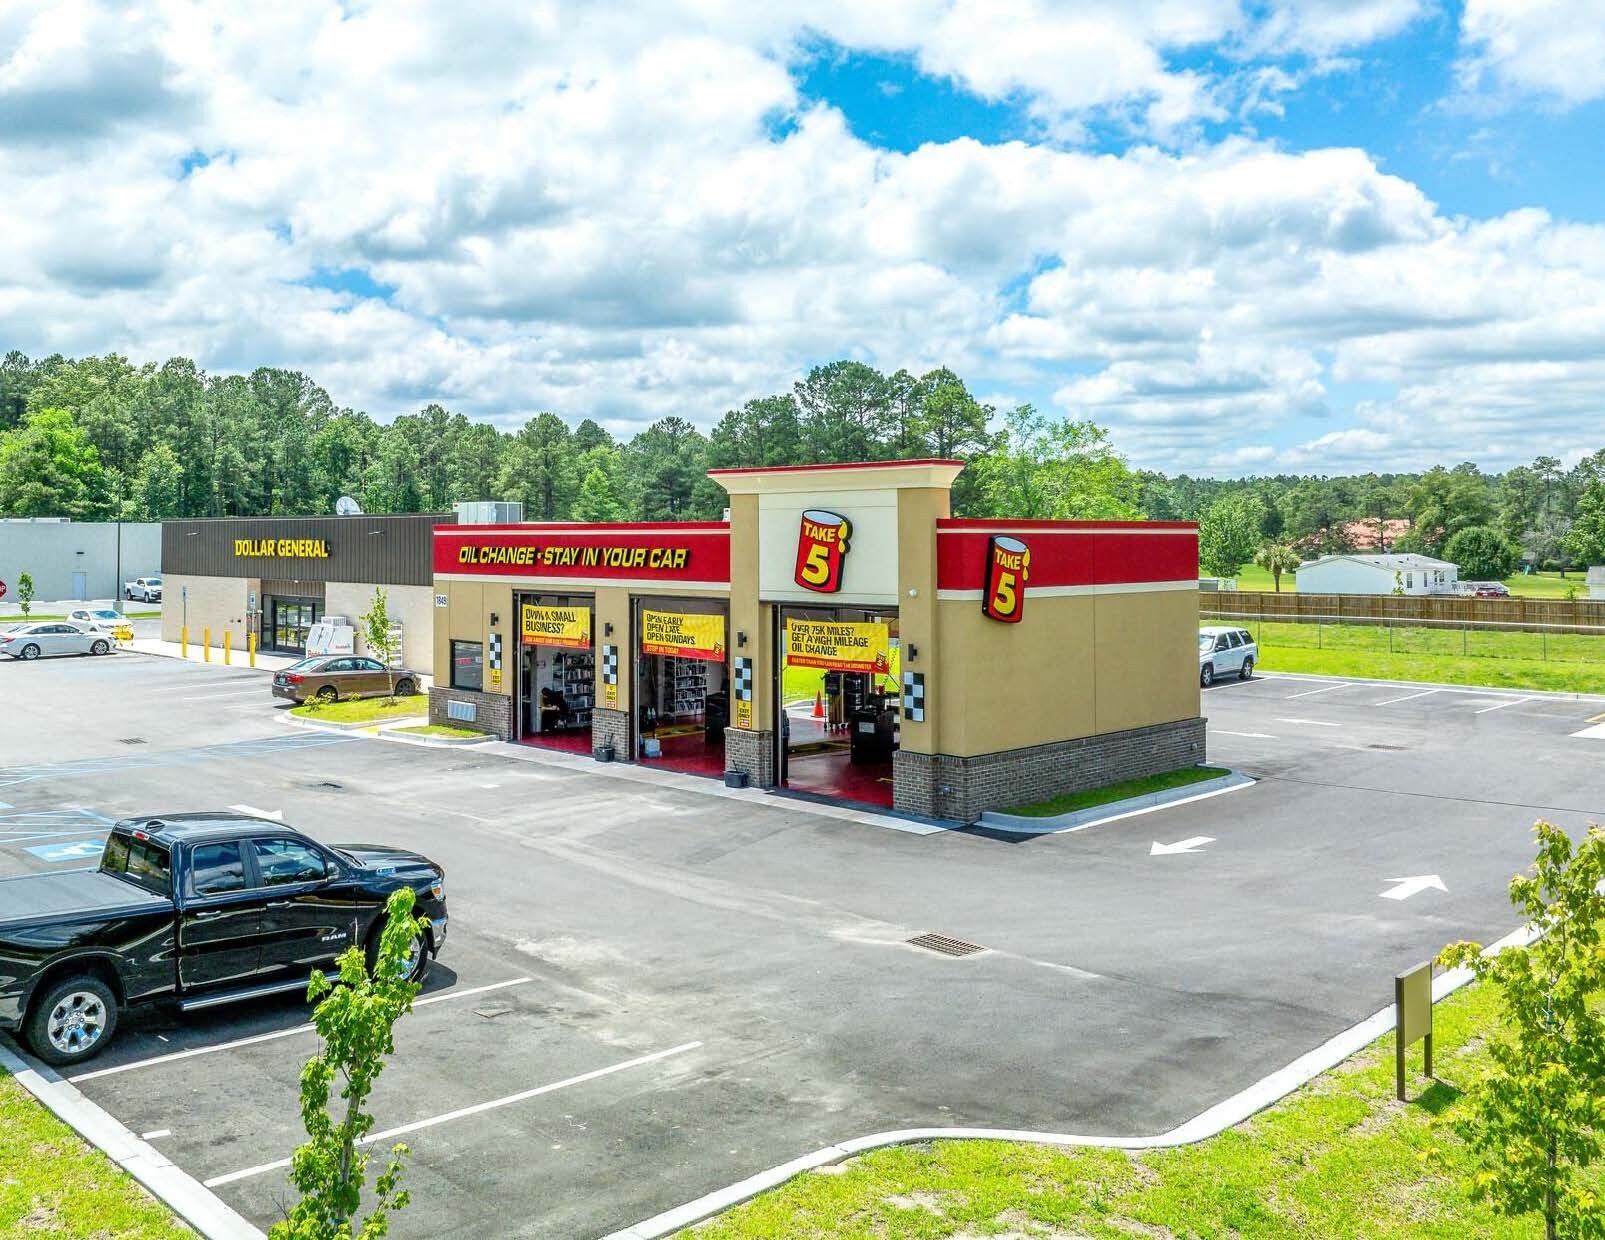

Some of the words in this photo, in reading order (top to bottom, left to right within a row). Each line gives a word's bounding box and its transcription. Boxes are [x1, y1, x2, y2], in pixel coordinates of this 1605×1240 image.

[803, 521, 836, 543] TAKE
[234, 539, 276, 557] DOLLAR
[277, 539, 329, 558] GENERAL
[459, 546, 478, 564] OIL
[480, 546, 535, 565] CHANGE
[543, 547, 579, 566] STAY
[582, 547, 599, 566] IN
[603, 547, 646, 568] YOUR
[649, 548, 687, 569] CAR
[801, 543, 829, 585] 5
[995, 548, 1021, 570] TAKE
[993, 571, 1016, 615] 5
[544, 611, 551, 621] A
[551, 611, 576, 623] SMALL
[646, 613, 662, 623] OPEN
[525, 620, 565, 635] BUSINESS?
[646, 622, 664, 633] OPEN
[791, 622, 810, 633] OVER
[811, 625, 826, 636] 75K
[827, 626, 855, 637] MILES?
[646, 631, 664, 642] OPEN
[791, 632, 806, 643] GET
[806, 635, 814, 643] A
[833, 636, 869, 648] MILEAGE
[791, 643, 804, 652] OIL
[805, 644, 838, 656] CHANGE
[321, 932, 347, 942] RAM
